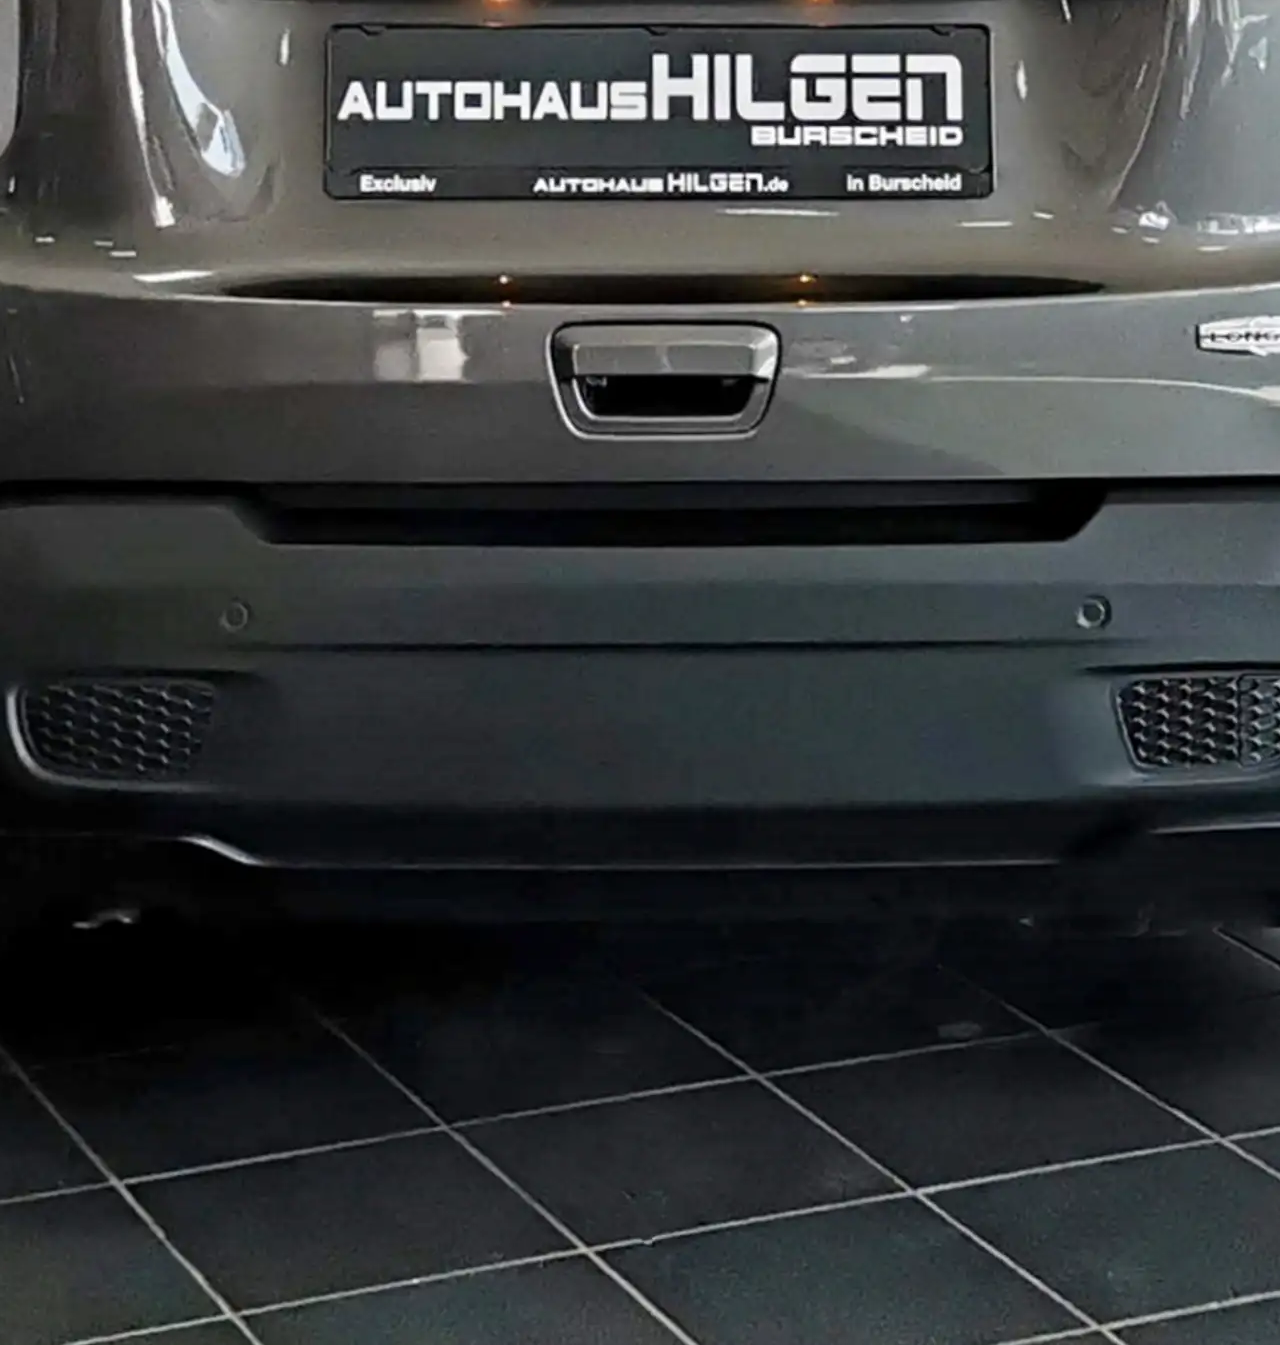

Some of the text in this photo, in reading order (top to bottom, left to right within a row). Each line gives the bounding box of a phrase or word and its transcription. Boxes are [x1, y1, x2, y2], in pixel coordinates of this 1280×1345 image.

[751, 125, 963, 147] BURSCHEID
[360, 173, 437, 193] Exclusiv
[533, 172, 789, 193] AUTOHAUS HILGEN.de
[847, 173, 962, 192] in Burscheid
